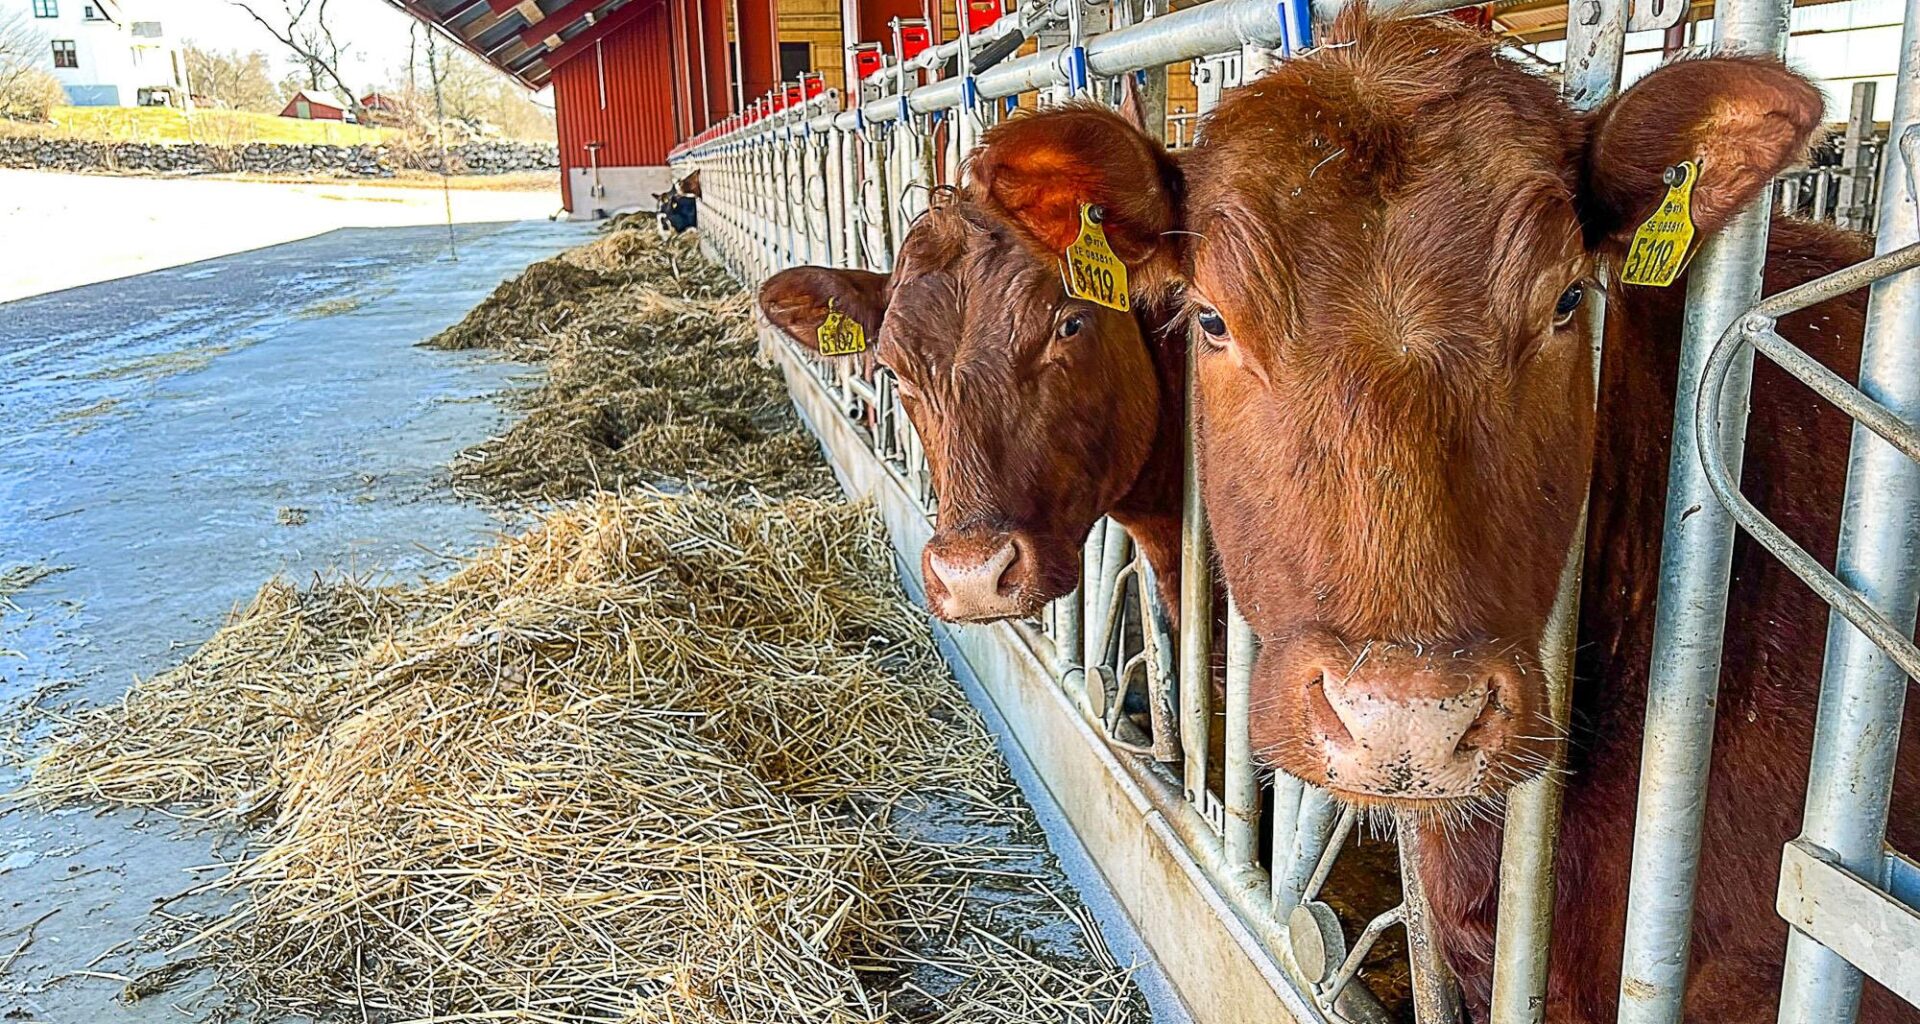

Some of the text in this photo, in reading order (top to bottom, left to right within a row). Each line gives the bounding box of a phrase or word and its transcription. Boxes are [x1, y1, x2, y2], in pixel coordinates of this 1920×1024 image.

[1074, 258, 1114, 303] 5119
[1626, 237, 1675, 281] 5119
[1119, 293, 1126, 307] 8
